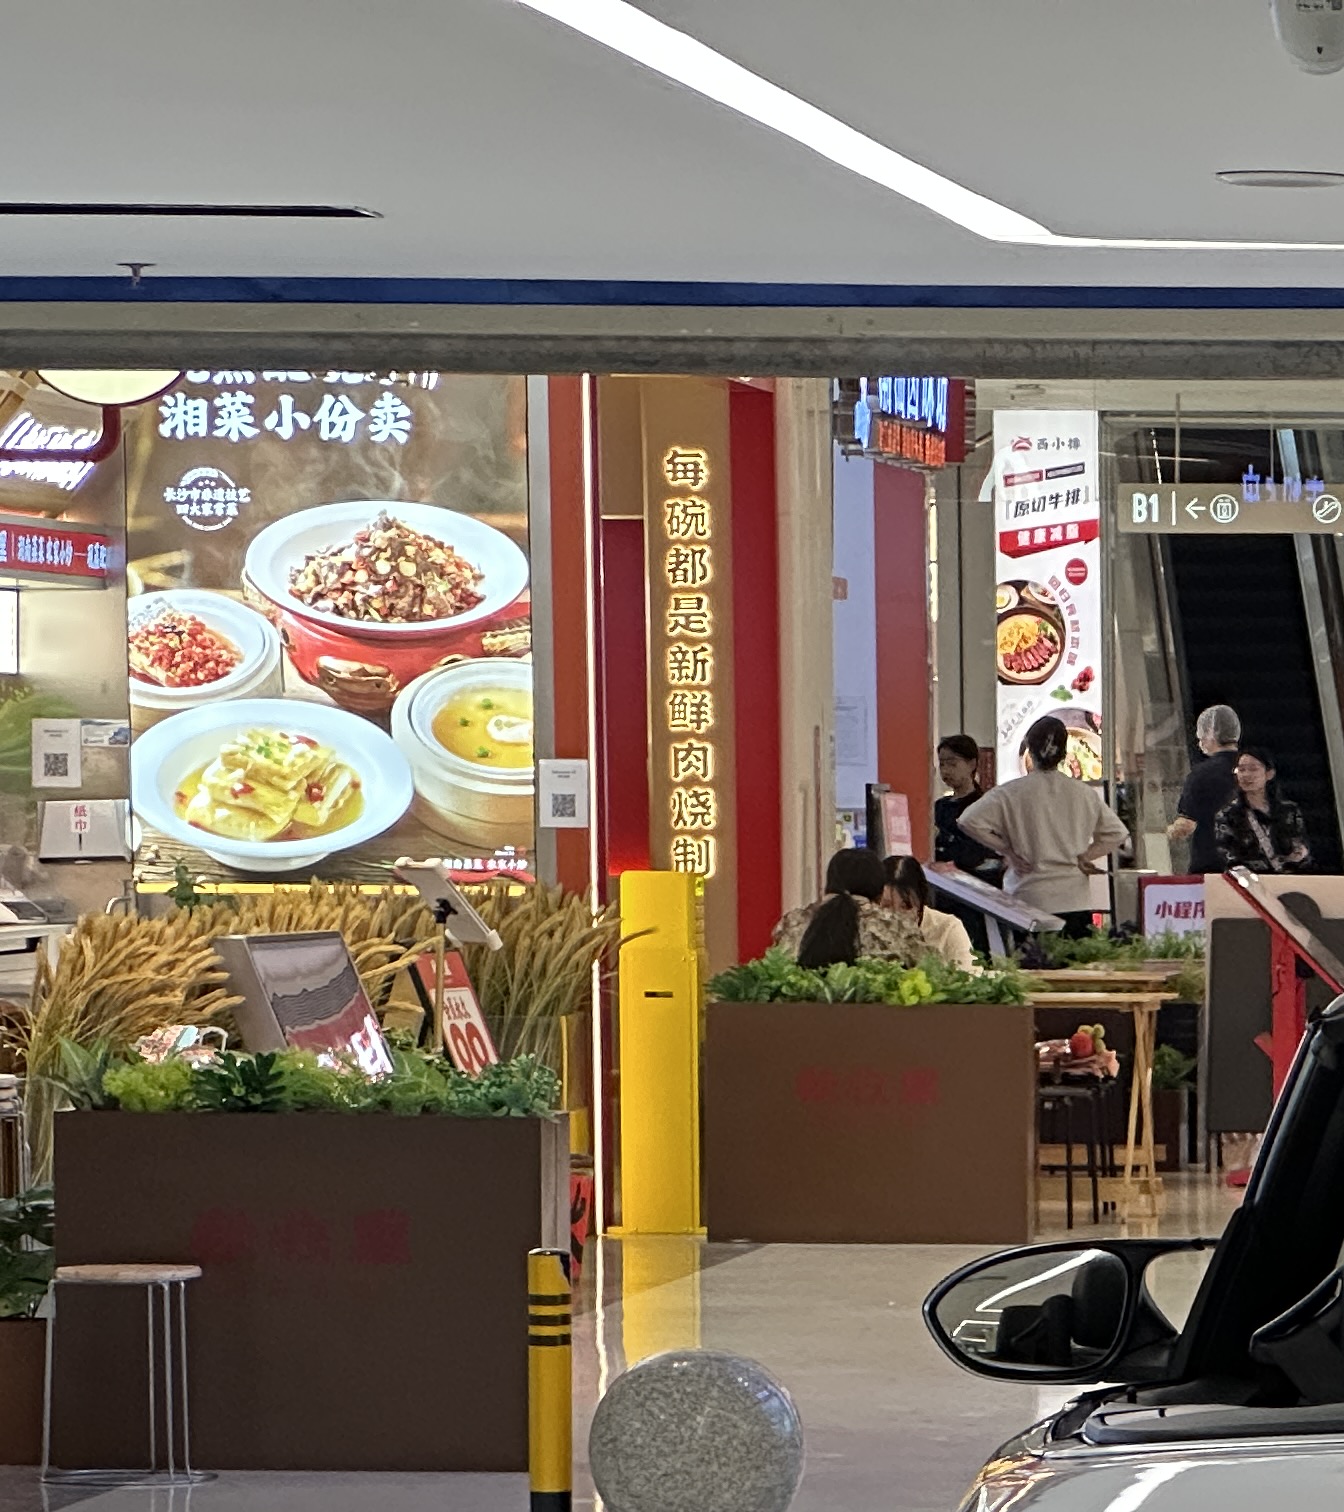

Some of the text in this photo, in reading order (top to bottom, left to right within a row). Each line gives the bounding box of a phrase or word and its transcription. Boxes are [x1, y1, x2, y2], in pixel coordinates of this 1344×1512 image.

[158, 390, 413, 444] 湘菜小份卖
[1132, 493, 1159, 523] B1
[665, 448, 717, 880] 每碗都是新鲜肉烧制
